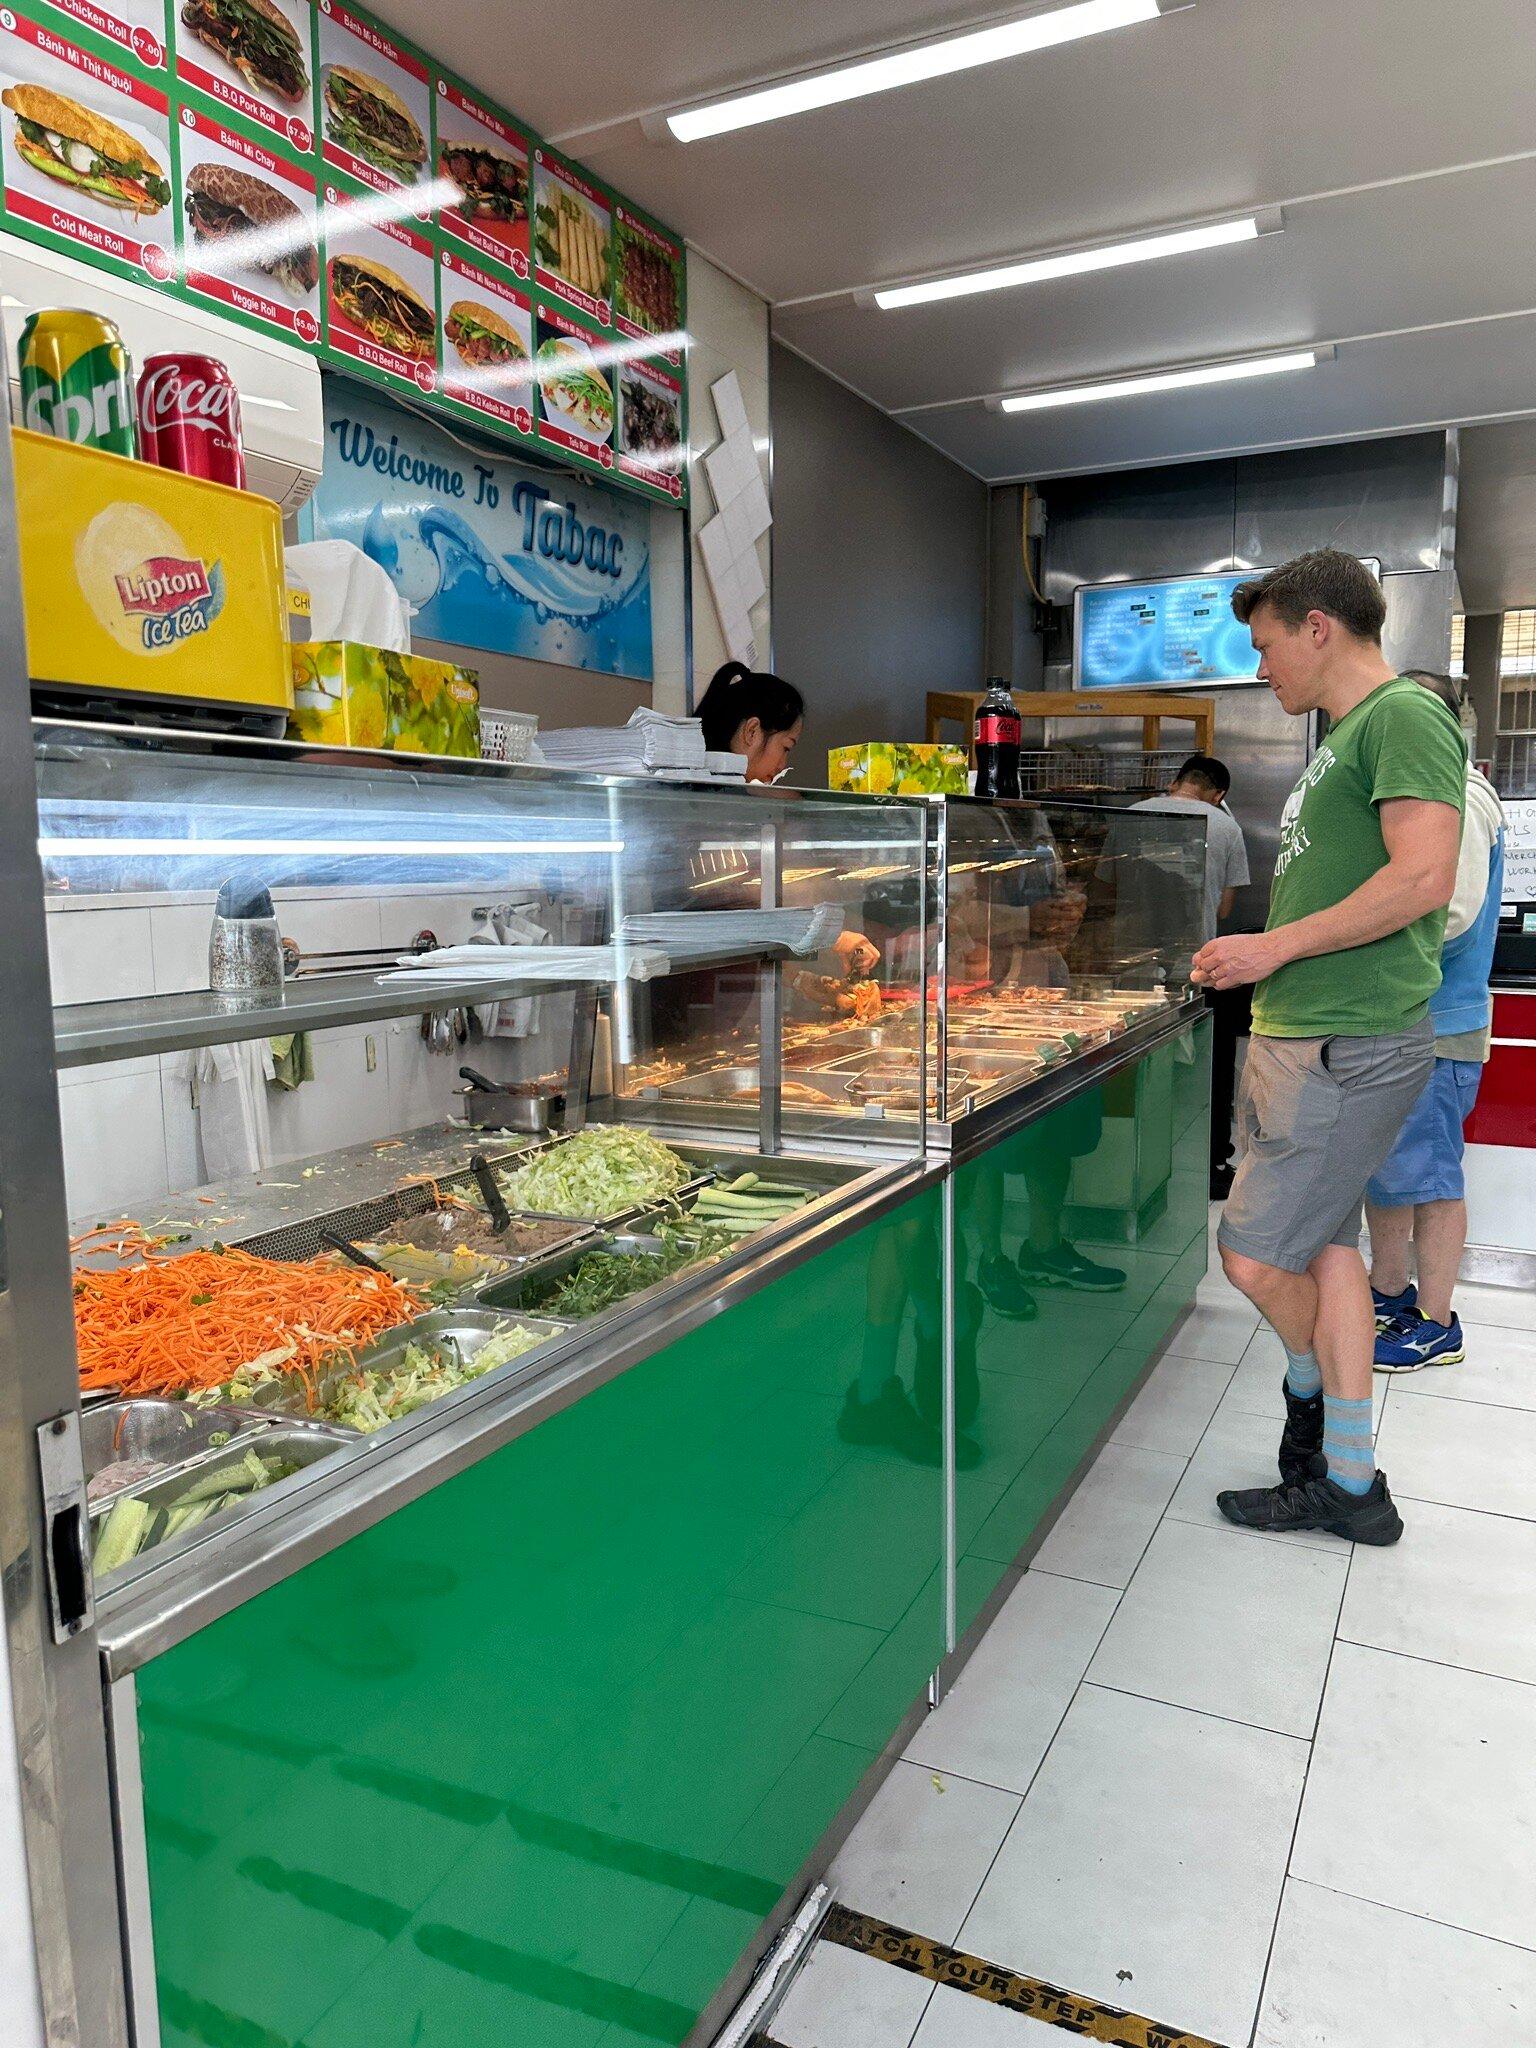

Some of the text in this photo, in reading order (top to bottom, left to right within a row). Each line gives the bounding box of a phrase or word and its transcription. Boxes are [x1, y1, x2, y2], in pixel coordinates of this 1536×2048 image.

[4, 13, 12, 26] 9
[107, 19, 127, 40] Roll
[344, 14, 362, 36] Bánh
[132, 35, 160, 58] $7.00
[37, 31, 65, 56] Bánh
[82, 55, 102, 77] Thịt
[103, 69, 132, 93] Nguội
[213, 80, 276, 125] B.B.Q Pork Roll
[183, 111, 194, 124] 10
[288, 125, 310, 143] $7.50
[220, 130, 242, 152] Bánh
[255, 146, 275, 171] Chay
[352, 161, 372, 180] Roast
[372, 173, 388, 190] Beef
[328, 189, 336, 202] 11
[52, 213, 124, 254] Cold Meat Roll
[468, 230, 505, 259] Meat Ball Roll
[461, 263, 476, 279] Bánh
[231, 289, 277, 318] Veggie Roll
[555, 281, 595, 311] Pork Spring Rolls
[296, 317, 316, 334] $5.00
[358, 345, 408, 374] B.B.Q Beef Roll
[481, 398, 499, 413] Kebab
[500, 404, 511, 418] Roll
[580, 441, 588, 452] Roll
[331, 418, 623, 578] Welcome To Tabac
[122, 571, 201, 606] Lipton
[143, 602, 207, 647] Ice Tea
[931, 1953, 1009, 1994] YOUR
[1018, 1987, 1096, 2023] STEP
